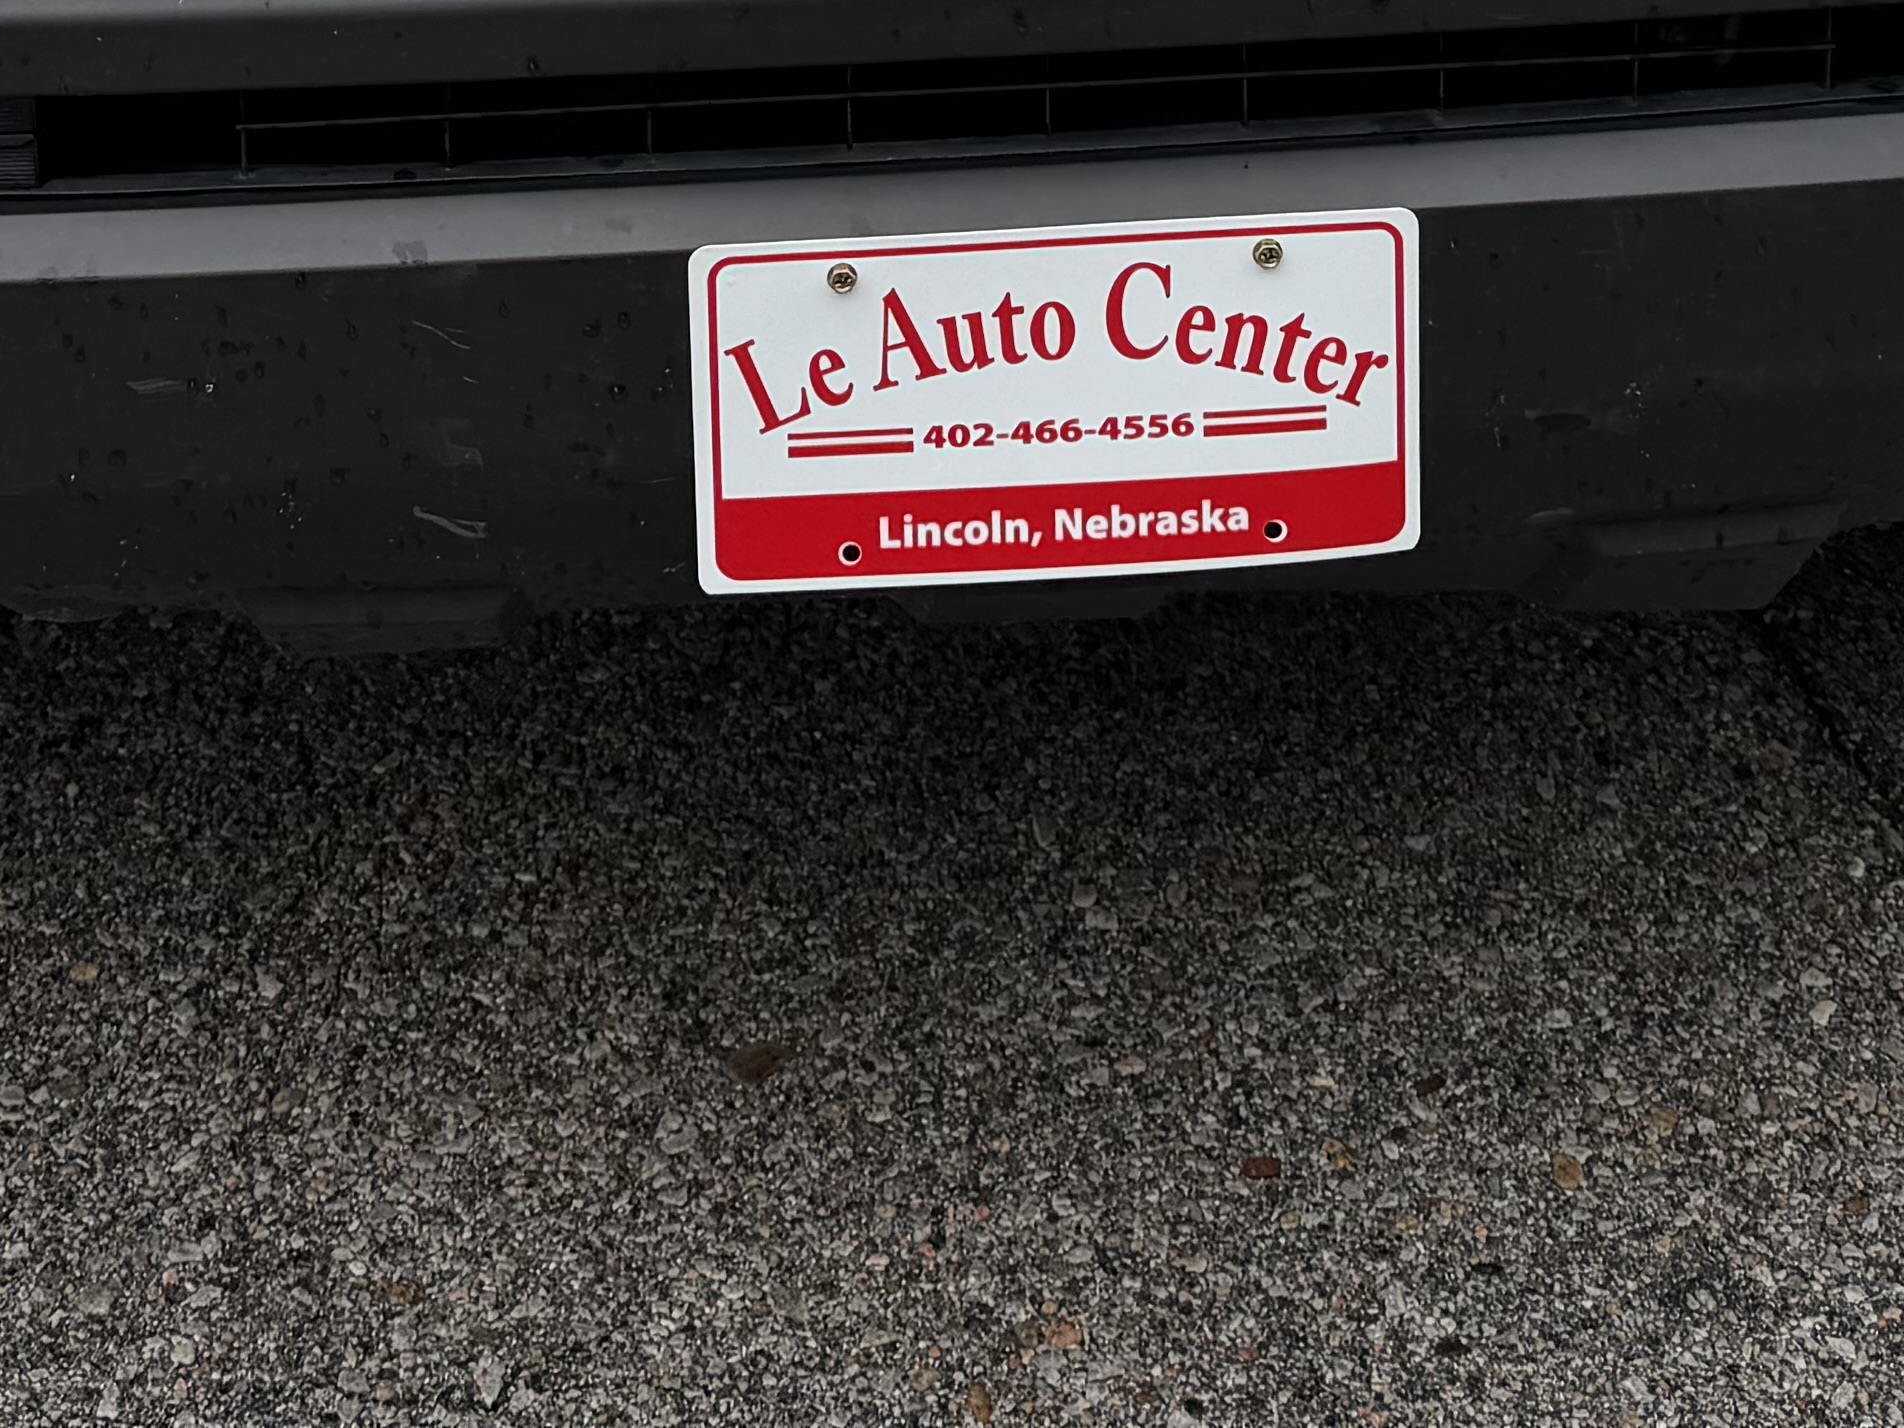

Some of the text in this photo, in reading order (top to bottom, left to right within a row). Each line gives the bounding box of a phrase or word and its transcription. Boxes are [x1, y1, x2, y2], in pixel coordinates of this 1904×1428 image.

[724, 262, 1389, 434] Le Auto Center
[923, 413, 1195, 448] 402-466-4556
[879, 499, 1250, 549] Lincoln, Nebraska
